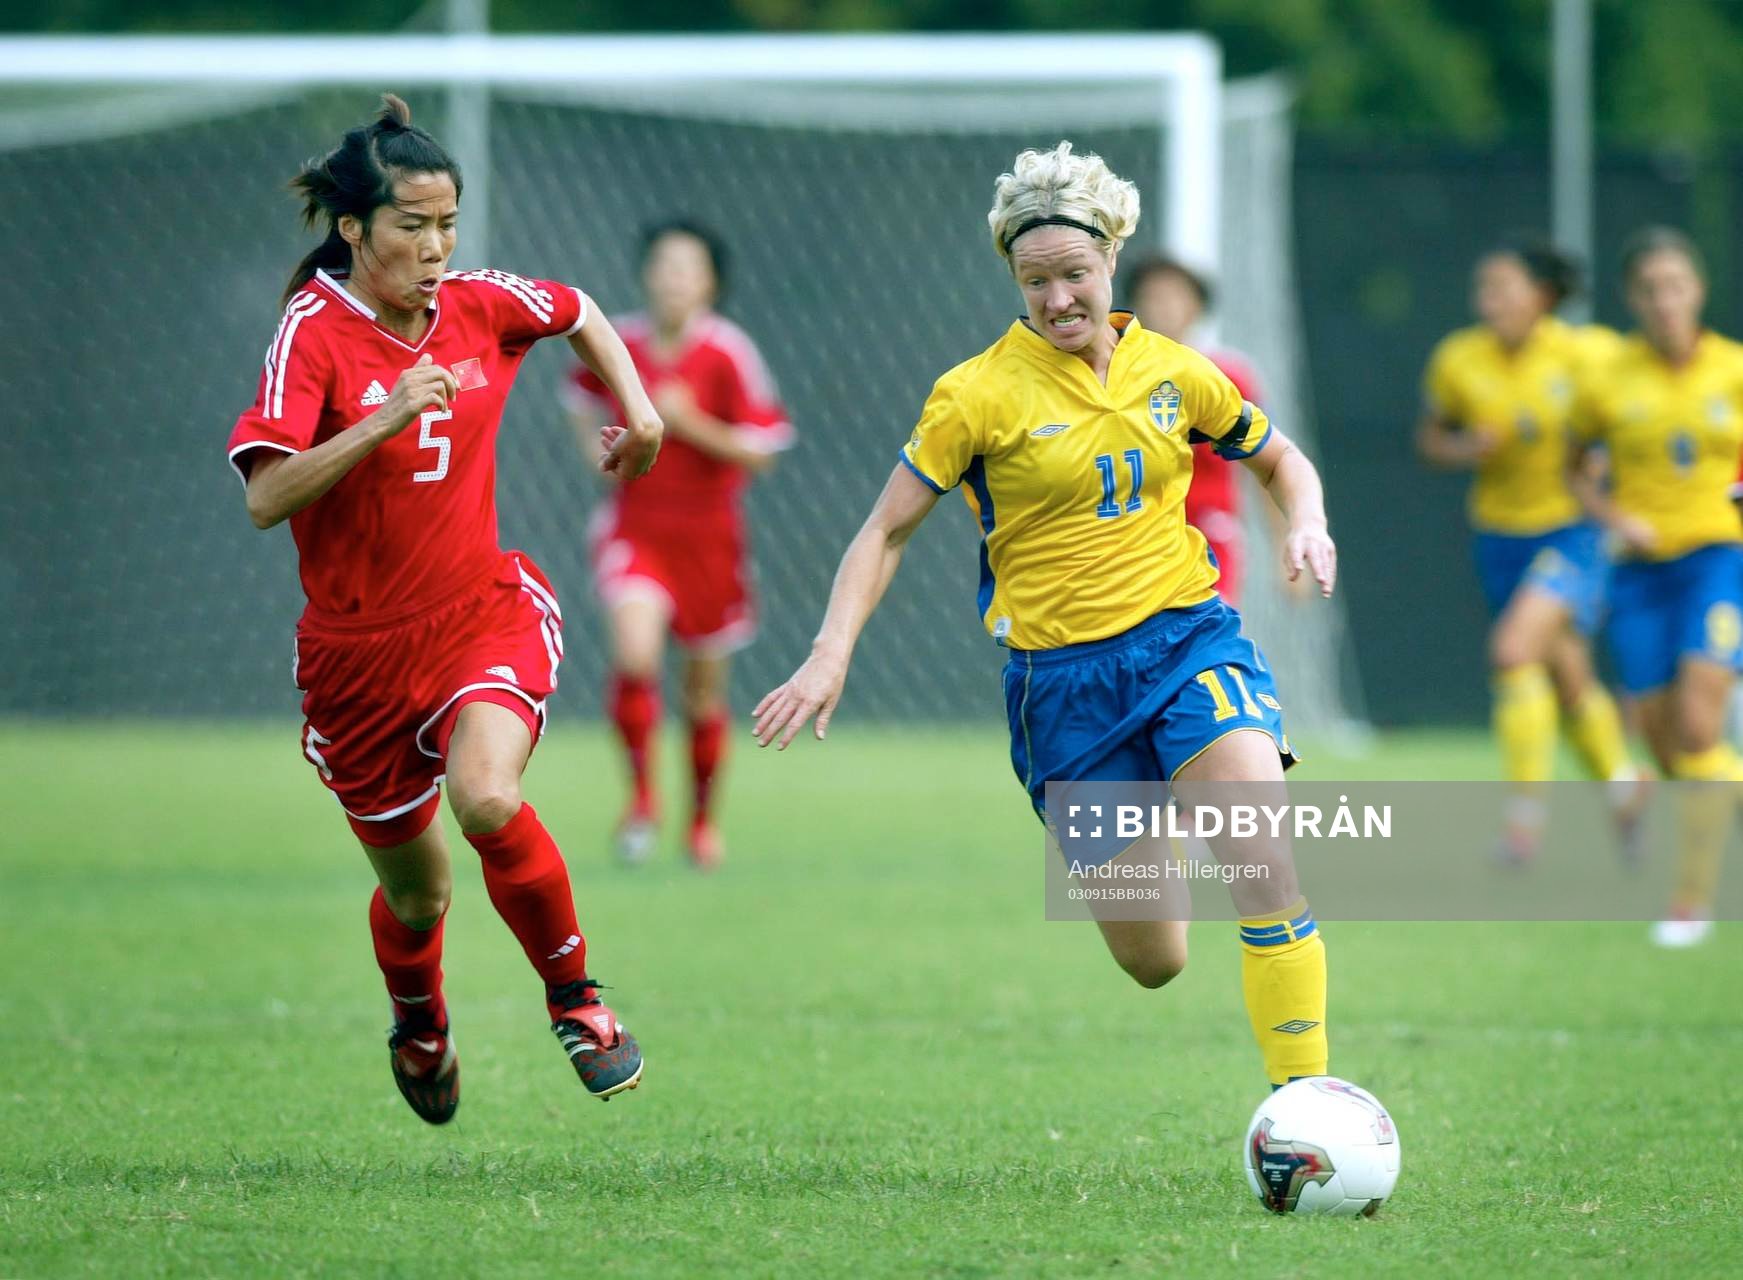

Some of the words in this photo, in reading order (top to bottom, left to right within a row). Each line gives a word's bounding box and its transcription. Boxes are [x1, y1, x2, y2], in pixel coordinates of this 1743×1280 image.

[413, 409, 453, 483] 5
[1094, 448, 1145, 519] 11
[1195, 664, 1263, 722] 11
